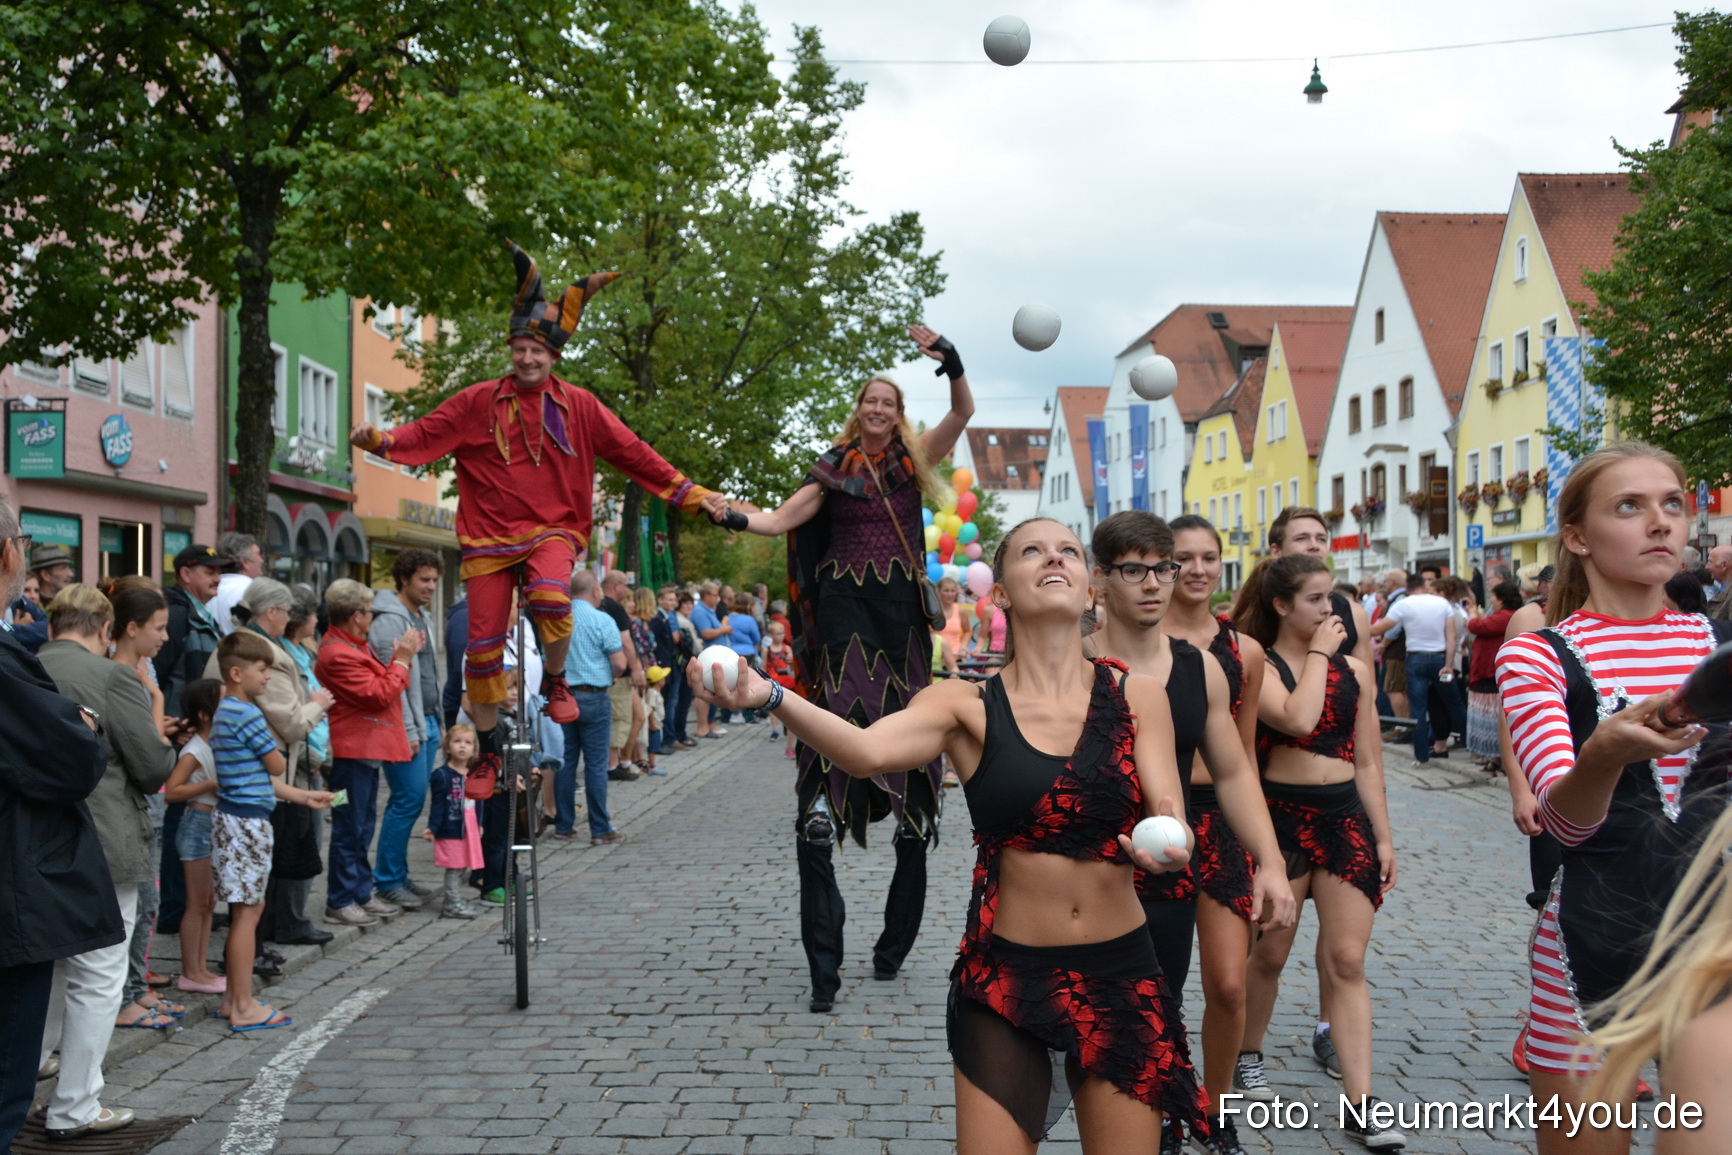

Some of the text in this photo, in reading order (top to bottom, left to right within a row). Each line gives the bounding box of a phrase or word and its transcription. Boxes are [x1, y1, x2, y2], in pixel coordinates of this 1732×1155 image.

[17, 422, 38, 436] vom
[24, 425, 56, 446] FASS
[101, 420, 119, 438] vom
[107, 431, 133, 460] FASS
[1470, 527, 1480, 547] P
